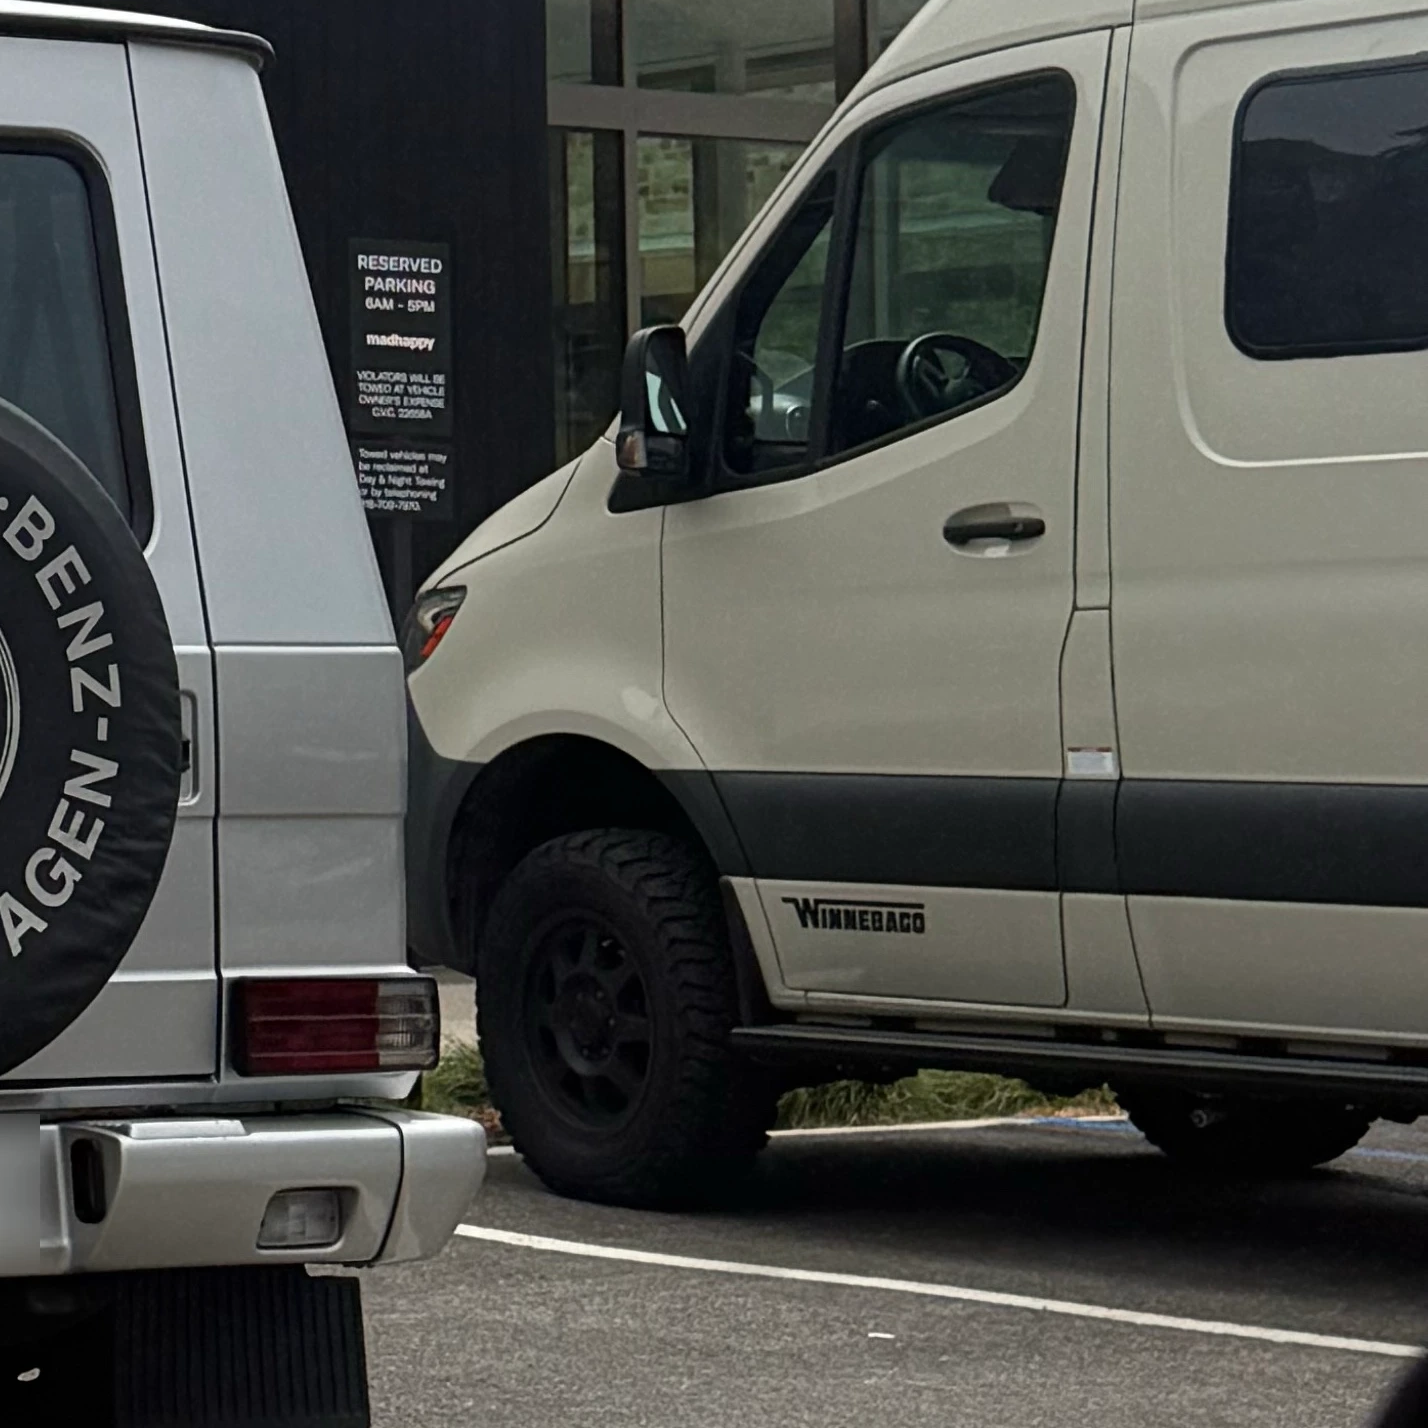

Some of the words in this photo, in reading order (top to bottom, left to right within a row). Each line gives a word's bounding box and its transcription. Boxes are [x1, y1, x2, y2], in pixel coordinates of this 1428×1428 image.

[357, 254, 442, 274] RESERVED
[364, 276, 436, 294] PARKING
[365, 297, 393, 310] 6AM
[407, 300, 435, 313] 5PM
[366, 333, 435, 351] madhappy
